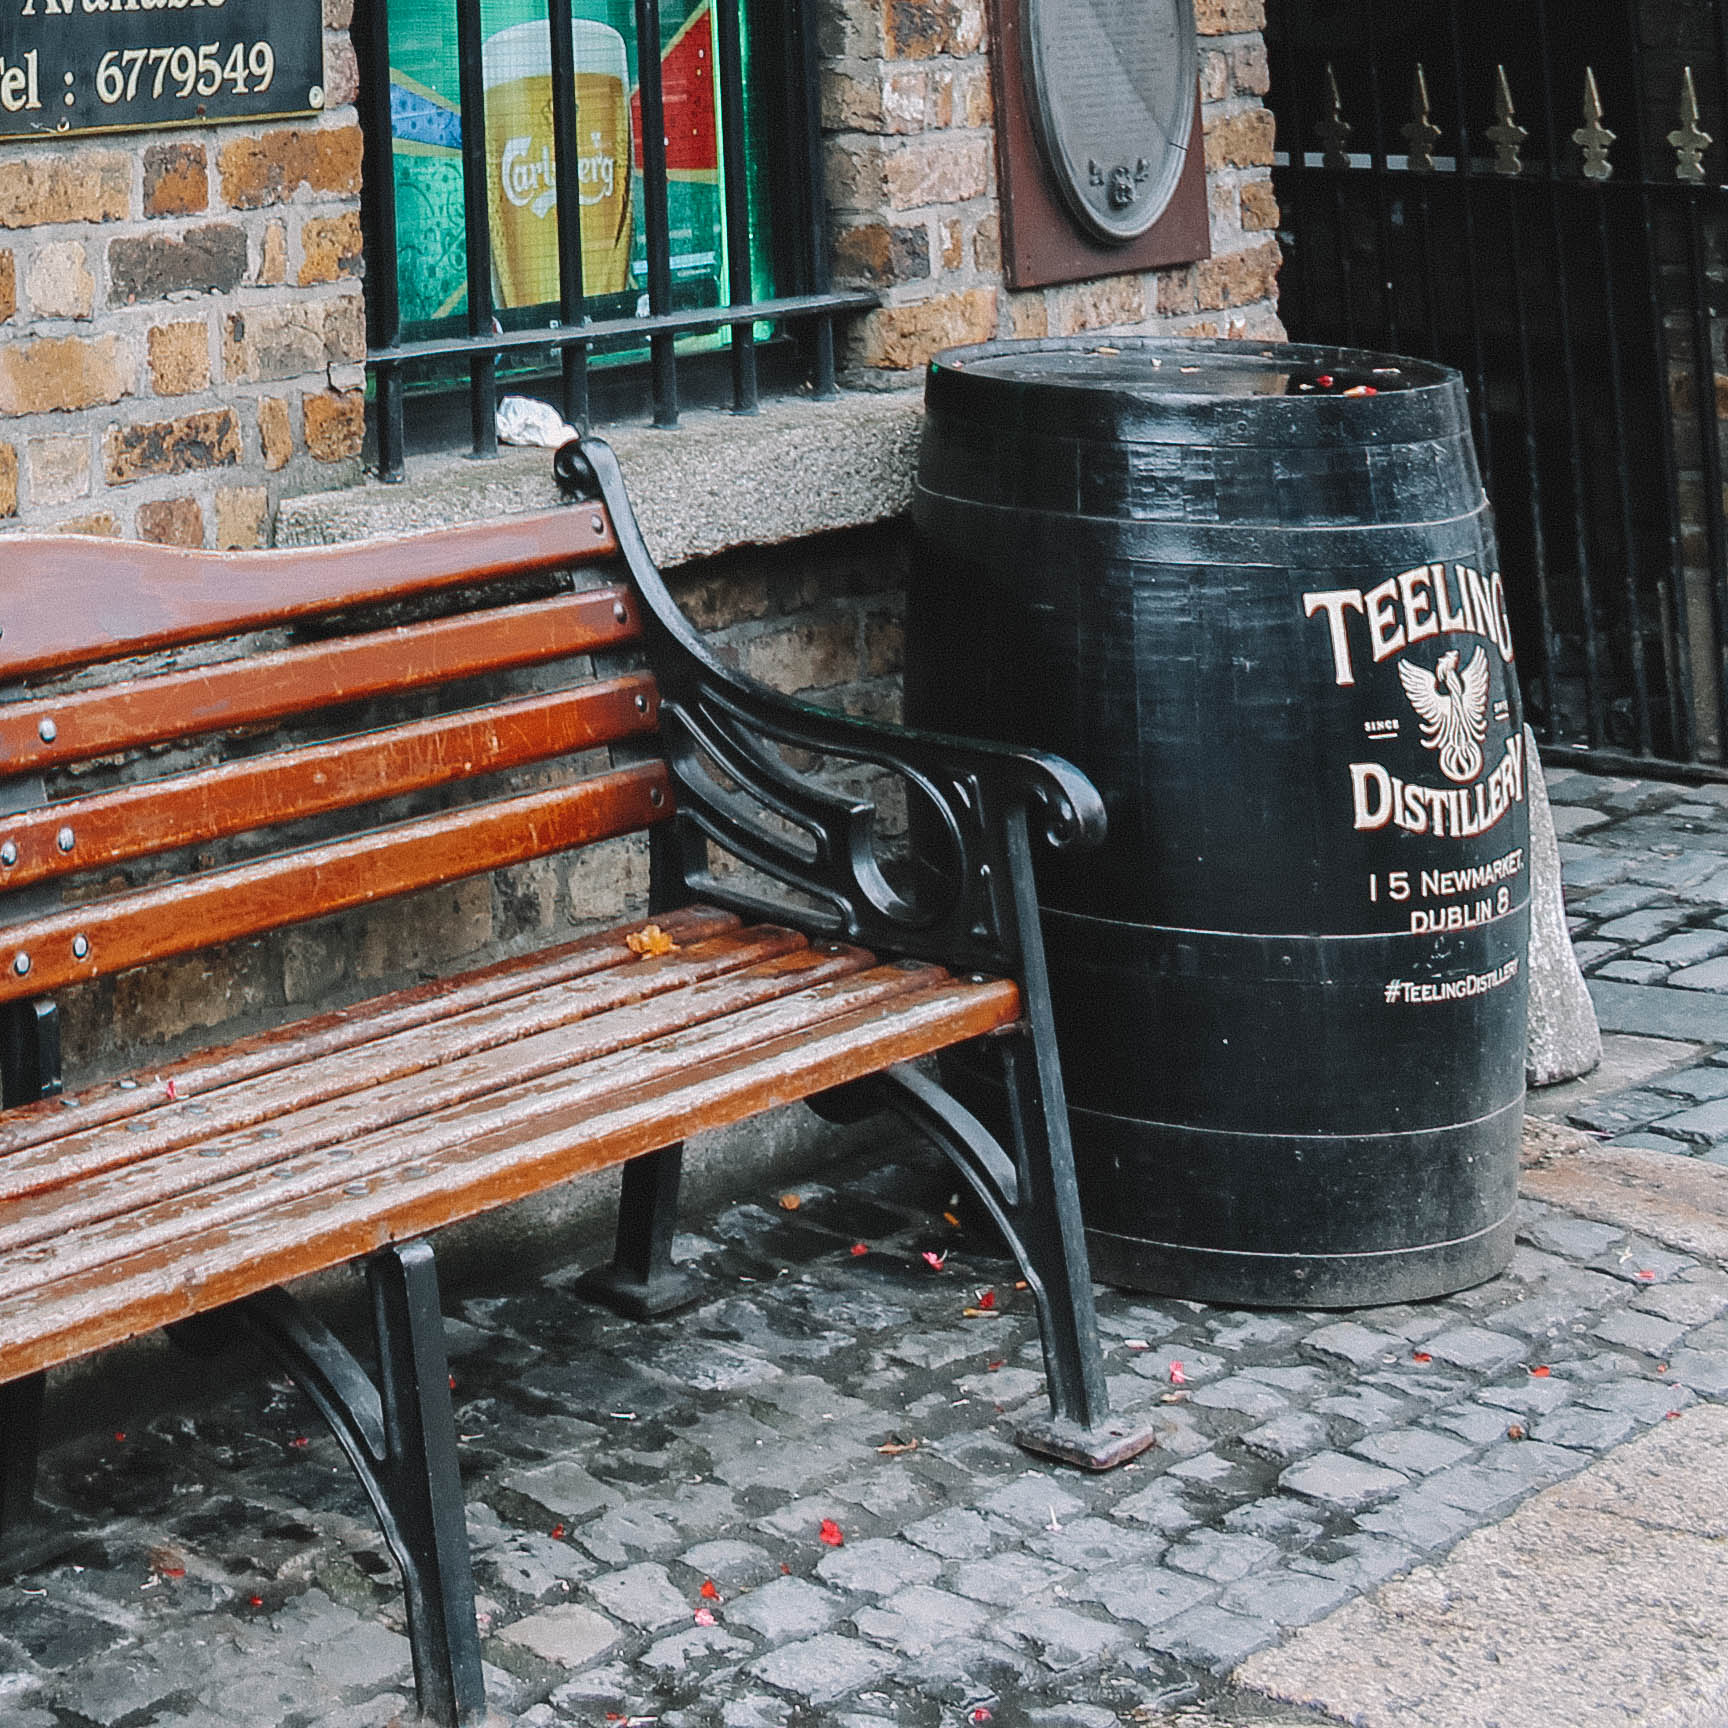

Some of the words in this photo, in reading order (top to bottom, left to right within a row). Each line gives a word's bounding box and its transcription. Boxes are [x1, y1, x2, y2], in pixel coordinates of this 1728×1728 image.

[94, 41, 275, 104] 6779549
[501, 135, 614, 207] Carlerg
[1302, 562, 1514, 686] TEELING
[1363, 718, 1400, 733] SINCE
[1348, 732, 1524, 840] DISTILLERY
[1410, 897, 1493, 934] DUBLIN
[1496, 885, 1510, 914] 8
